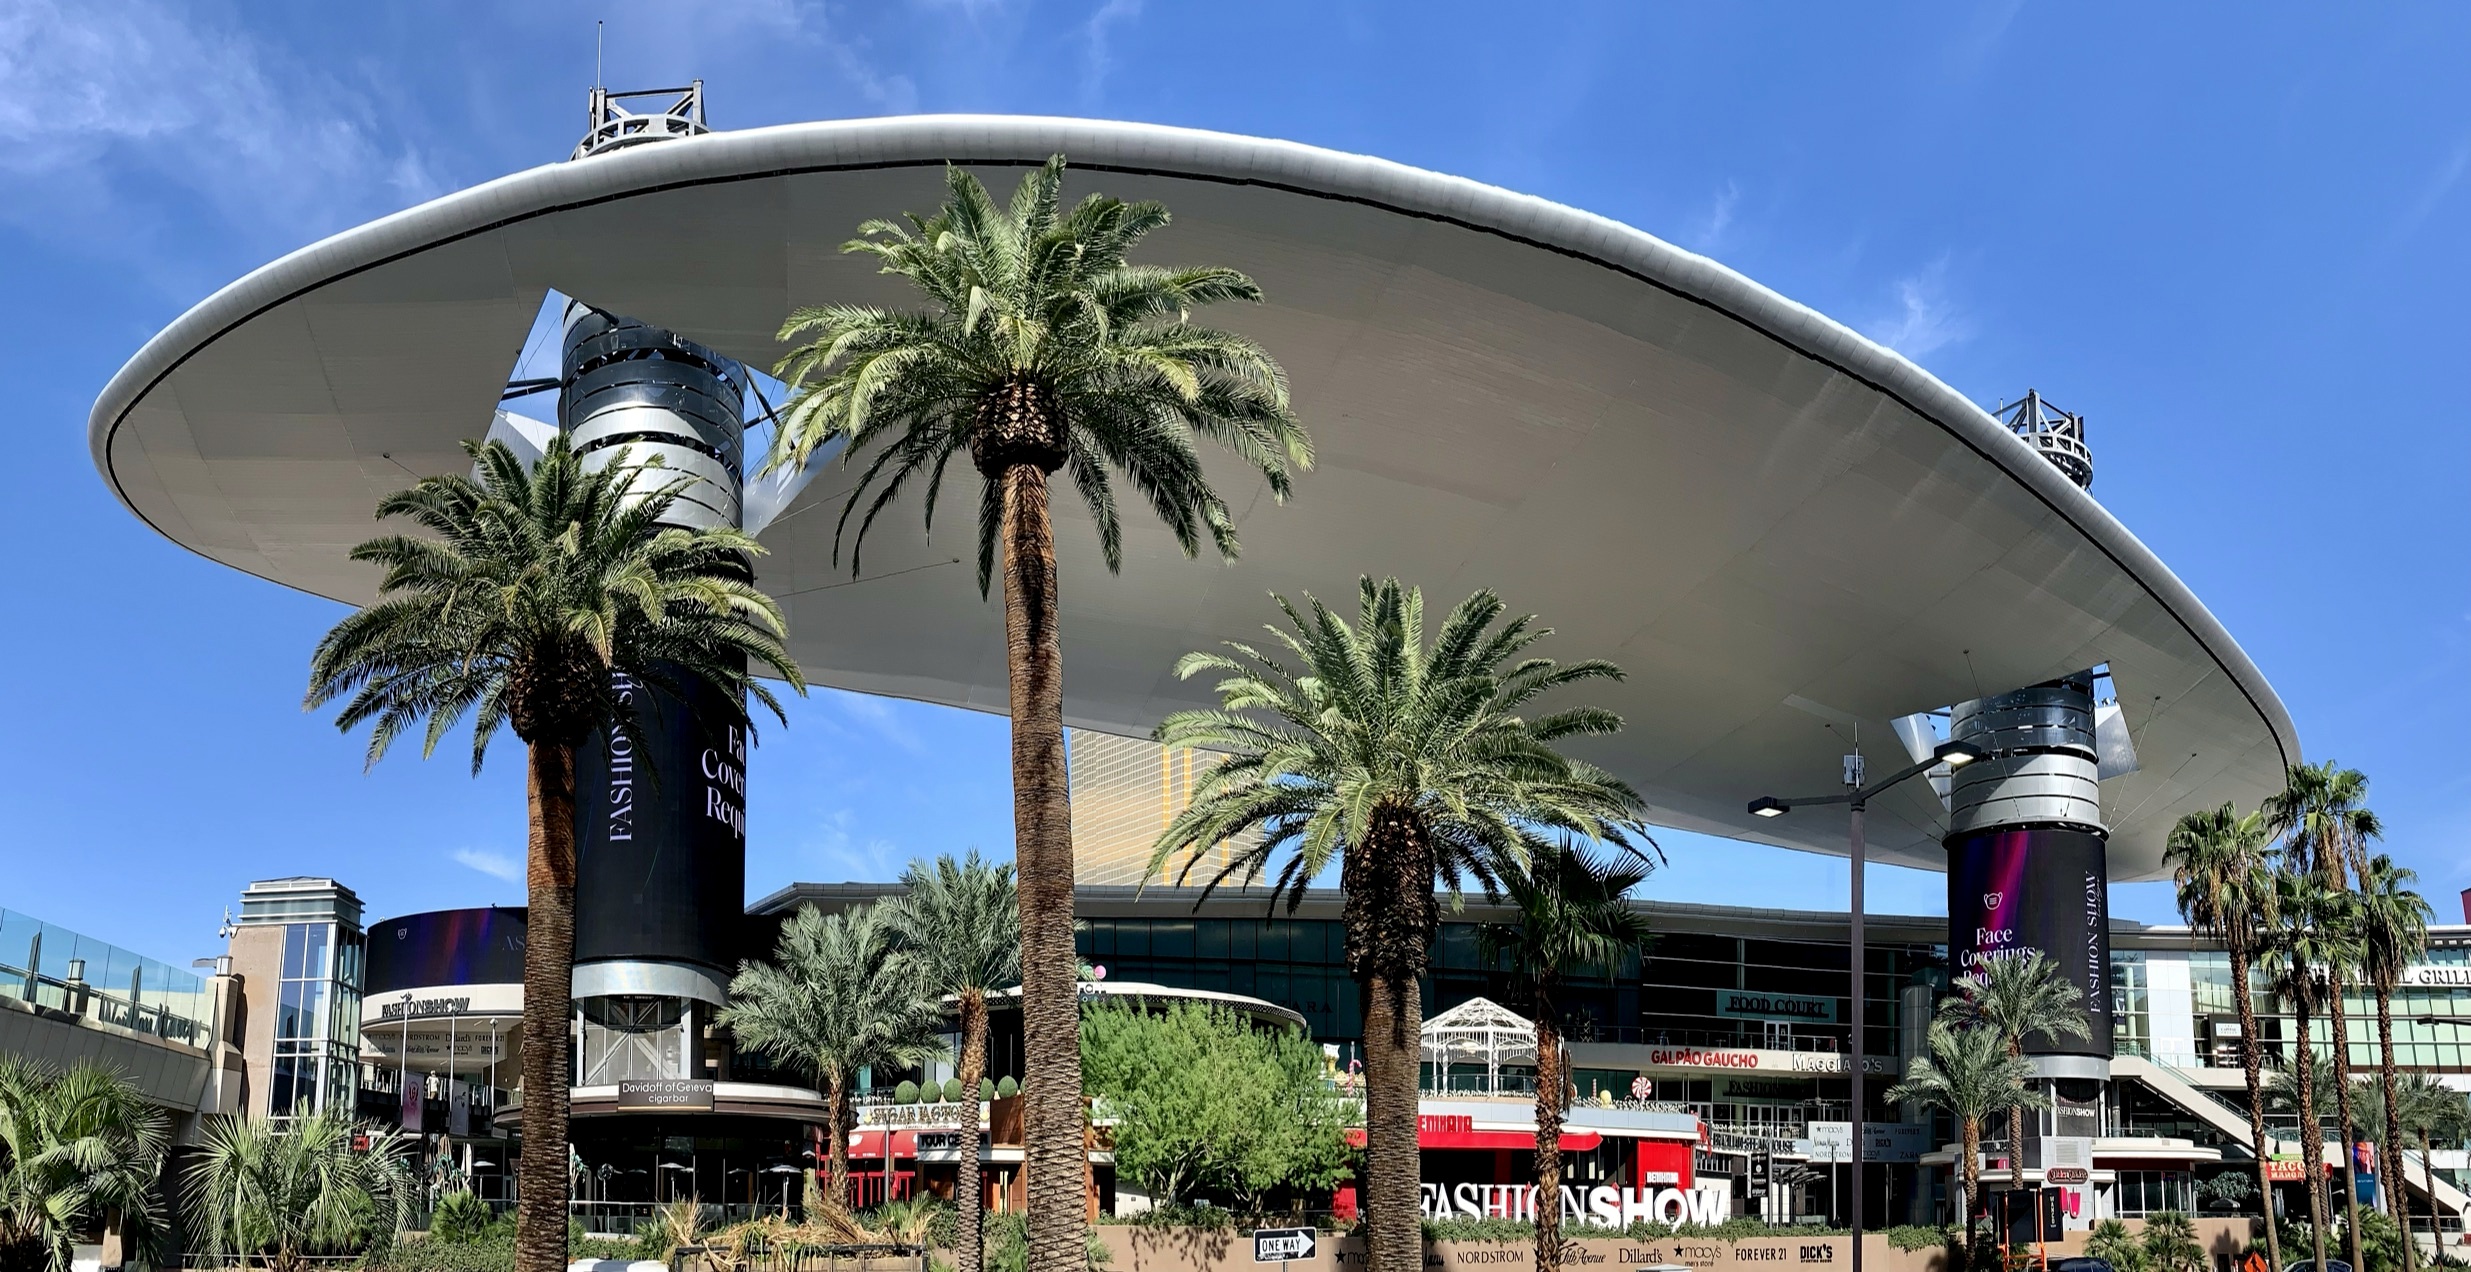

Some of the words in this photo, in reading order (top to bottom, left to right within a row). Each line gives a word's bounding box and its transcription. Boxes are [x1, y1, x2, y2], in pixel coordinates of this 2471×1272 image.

[2085, 870, 2098, 927] SHOW
[1976, 927, 2013, 946] Face
[2087, 931, 2101, 1013] FASHION
[1729, 996, 1771, 1011] FOOD
[1775, 999, 1825, 1015] COURT
[1651, 1047, 1702, 1066] GALPÃO
[1703, 1051, 1759, 1069] GAUCHO
[1792, 1053, 1883, 1073] MAGGIAO'S
[622, 1082, 662, 1093] Davidoff
[665, 1082, 675, 1093] of
[919, 1103, 961, 1122] FACTO
[2057, 1105, 2096, 1118] ASHIONSHOW
[920, 1132, 947, 1147] TOUR
[1815, 1150, 1852, 1159] NORDTROM
[1262, 1239, 1280, 1252] ONE
[1282, 1238, 1301, 1252] WAY
[1684, 1244, 1722, 1261] macy's
[1800, 1243, 1833, 1259] DICK'S
[1457, 1251, 1524, 1264] NORDSTROM
[1619, 1247, 1663, 1264] Dillard's
[1735, 1247, 1775, 1261] FOREVER
[1778, 1248, 1787, 1261] 21
